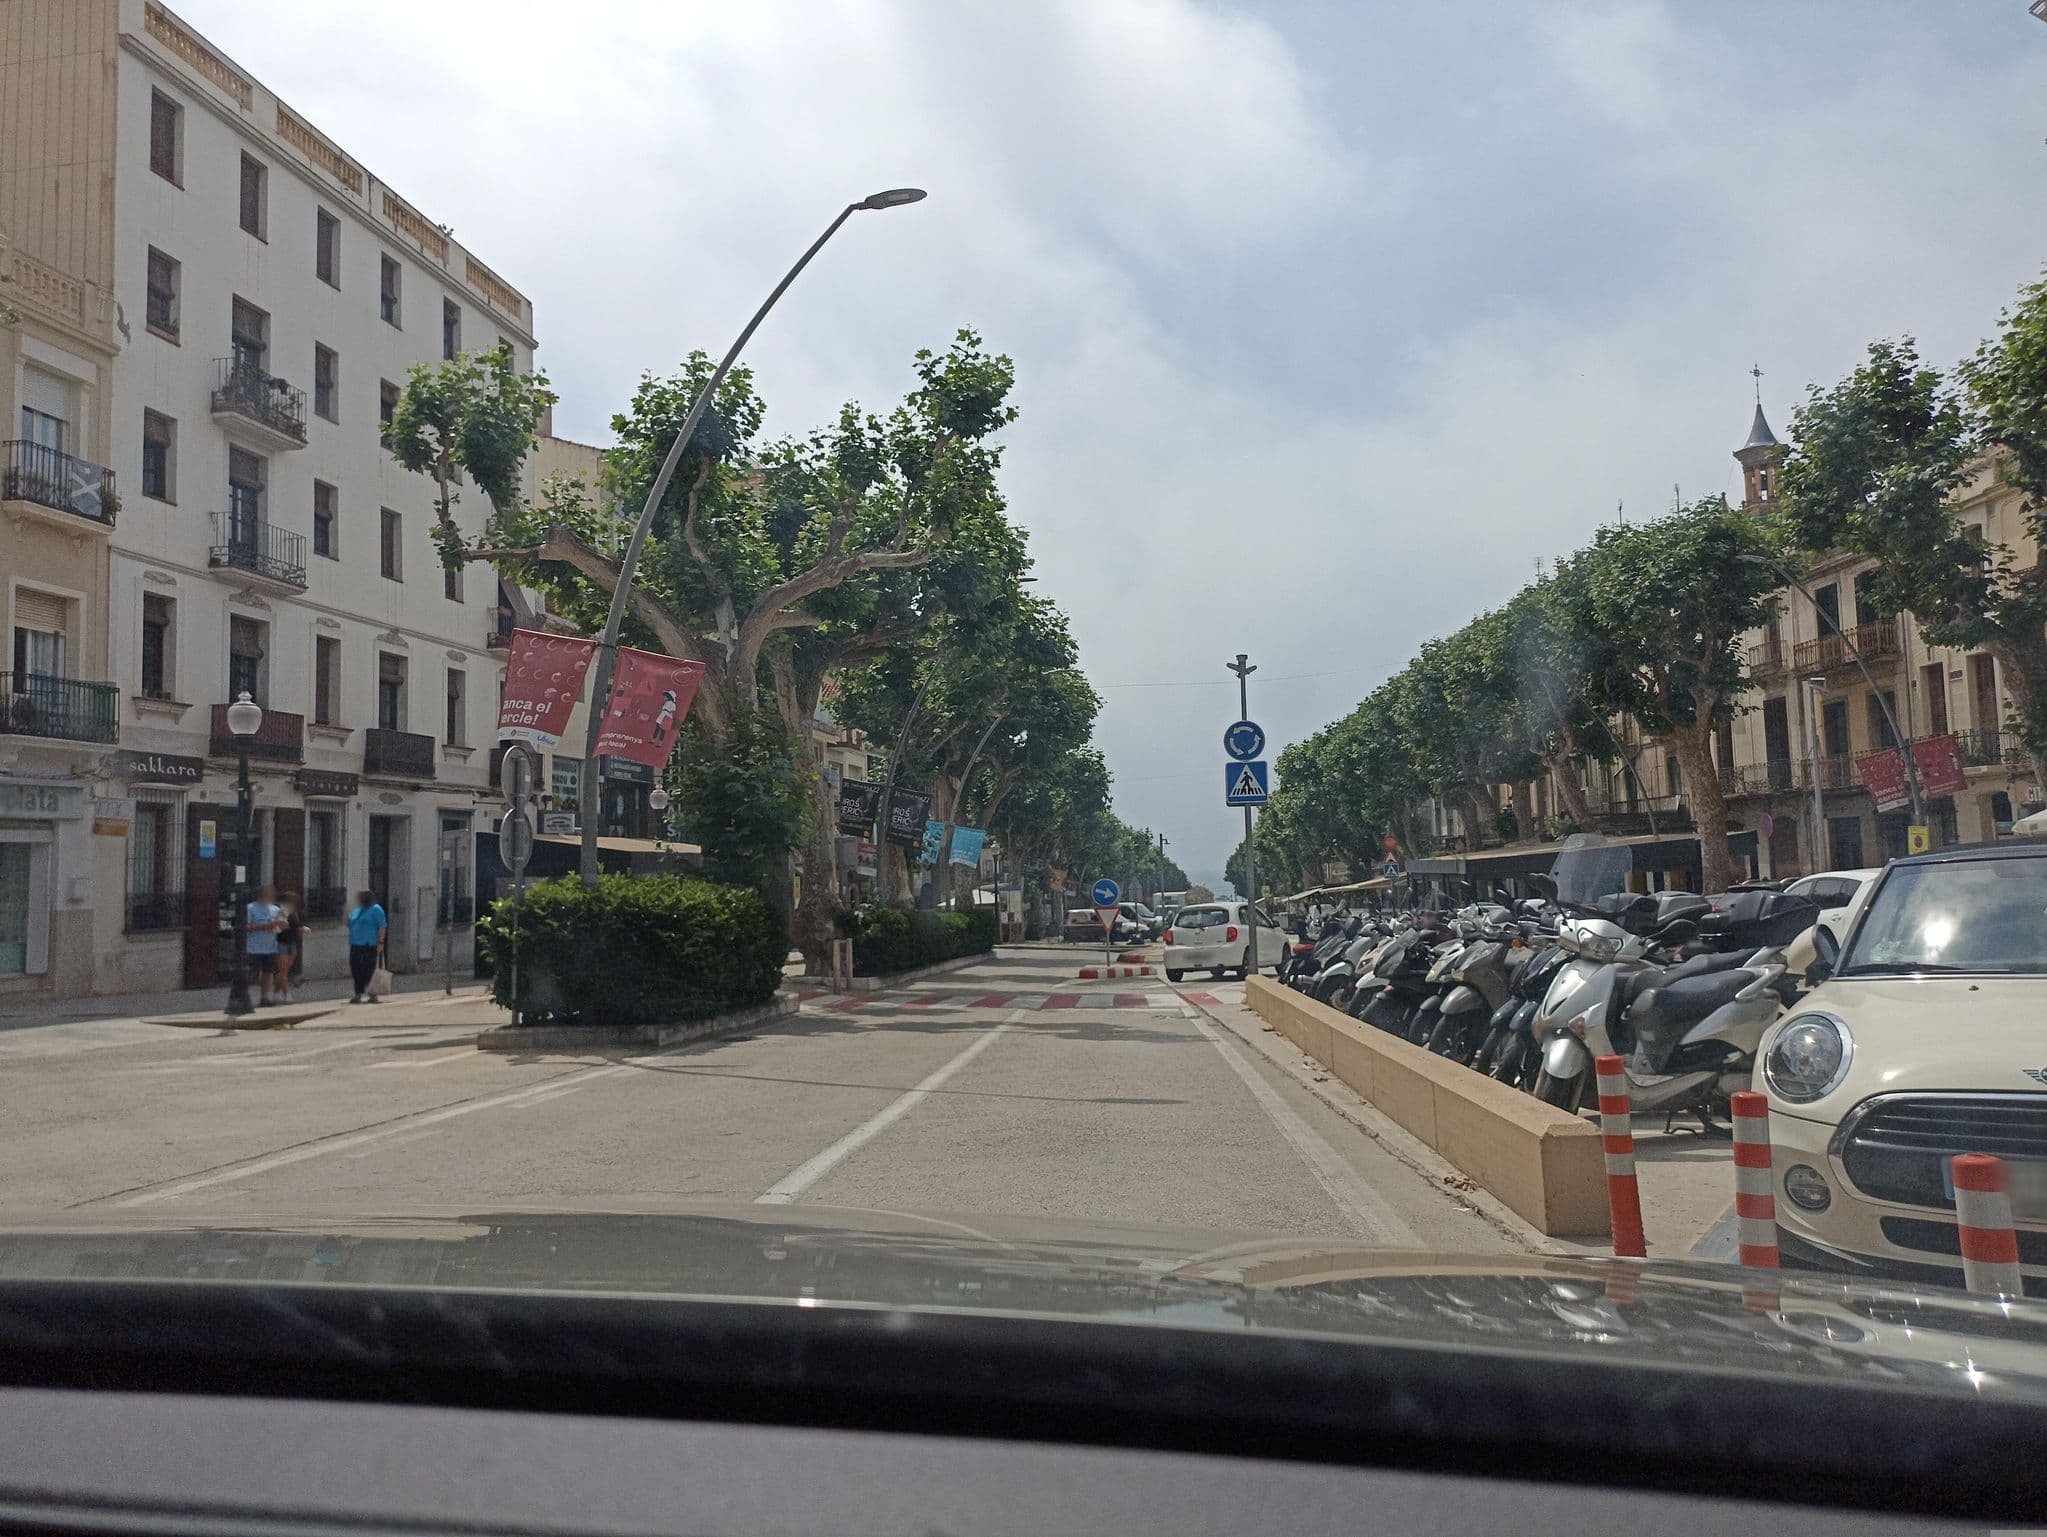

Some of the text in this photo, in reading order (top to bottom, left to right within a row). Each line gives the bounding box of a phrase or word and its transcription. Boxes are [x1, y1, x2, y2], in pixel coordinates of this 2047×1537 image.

[502, 699, 552, 714] anca el
[501, 711, 539, 726] ercle!
[128, 756, 197, 777] sakkara
